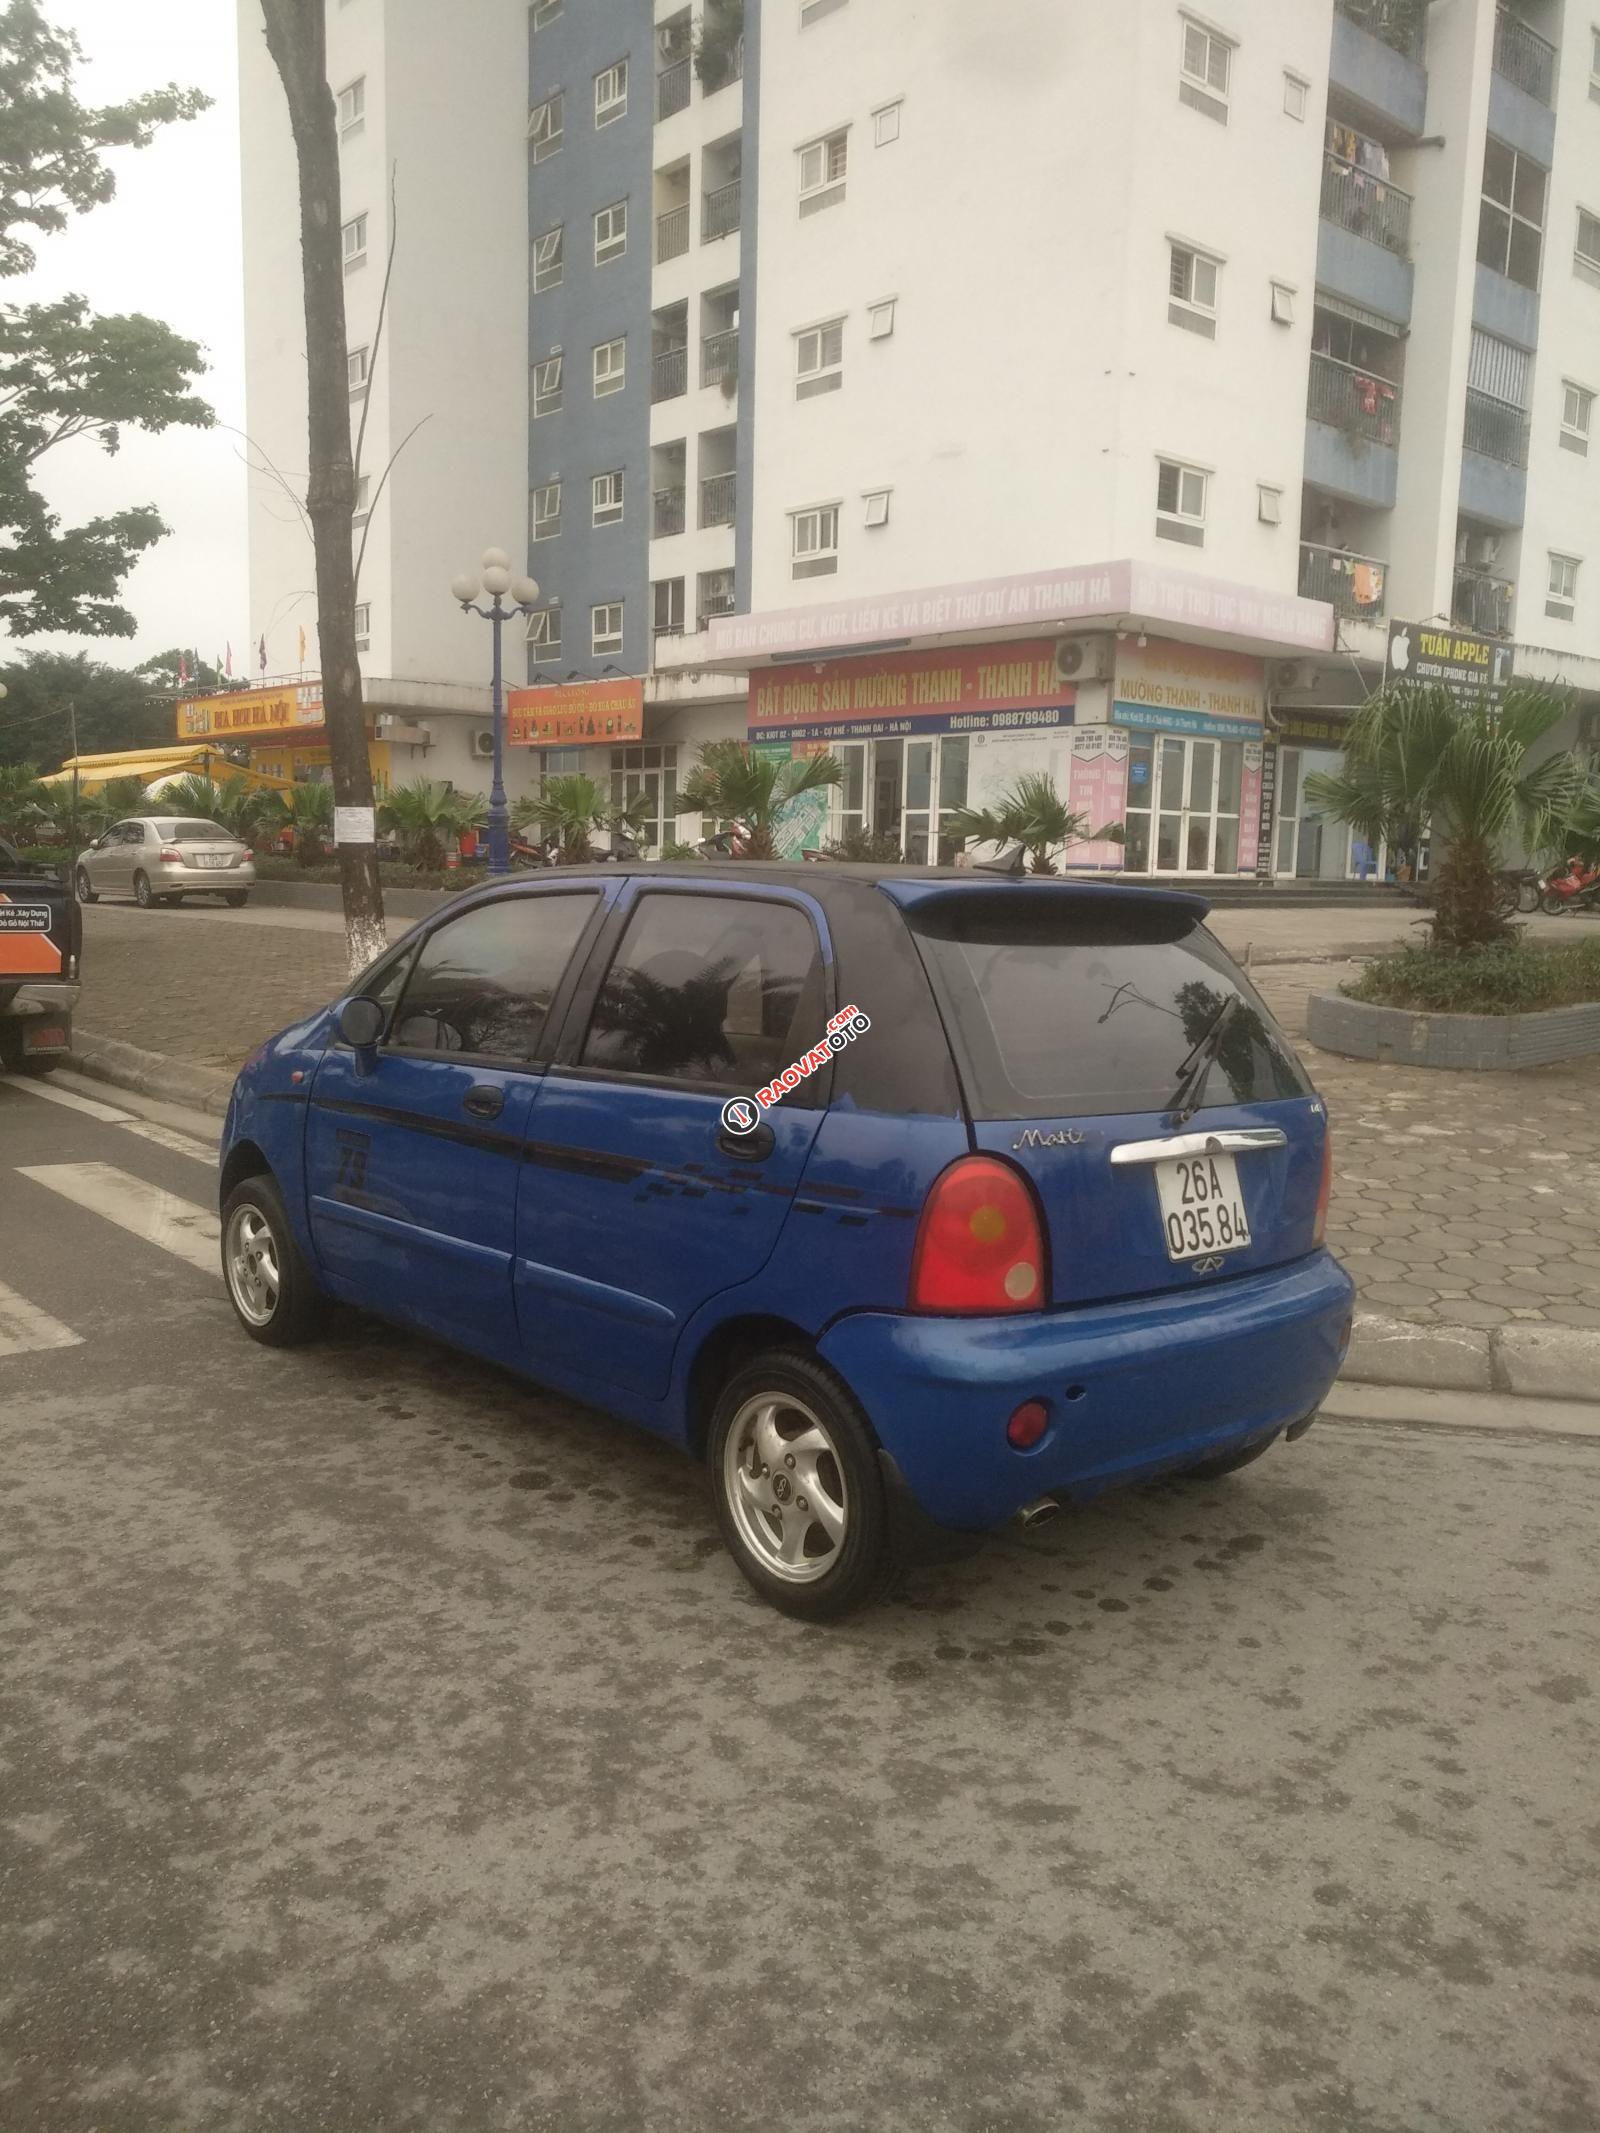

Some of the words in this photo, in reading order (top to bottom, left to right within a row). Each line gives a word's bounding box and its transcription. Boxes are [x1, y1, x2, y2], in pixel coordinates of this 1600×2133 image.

[1035, 579, 1084, 610] THANH
[1089, 572, 1111, 602] HÀ
[1420, 632, 1452, 658] TUẤN
[1453, 640, 1490, 665] APPLE
[854, 667, 907, 709] MƯỜNG
[912, 668, 962, 705] THANH
[977, 661, 1032, 700] THANH
[1443, 666, 1467, 681] IPHONE
[1166, 684, 1201, 708] THANH
[1208, 691, 1242, 713] THANH
[851, 723, 871, 734] THANH
[950, 714, 990, 729] Hotline:
[992, 709, 1060, 727] 0988799480
[1176, 1157, 1223, 1205] 26A
[1167, 1201, 1248, 1255] 035.84
